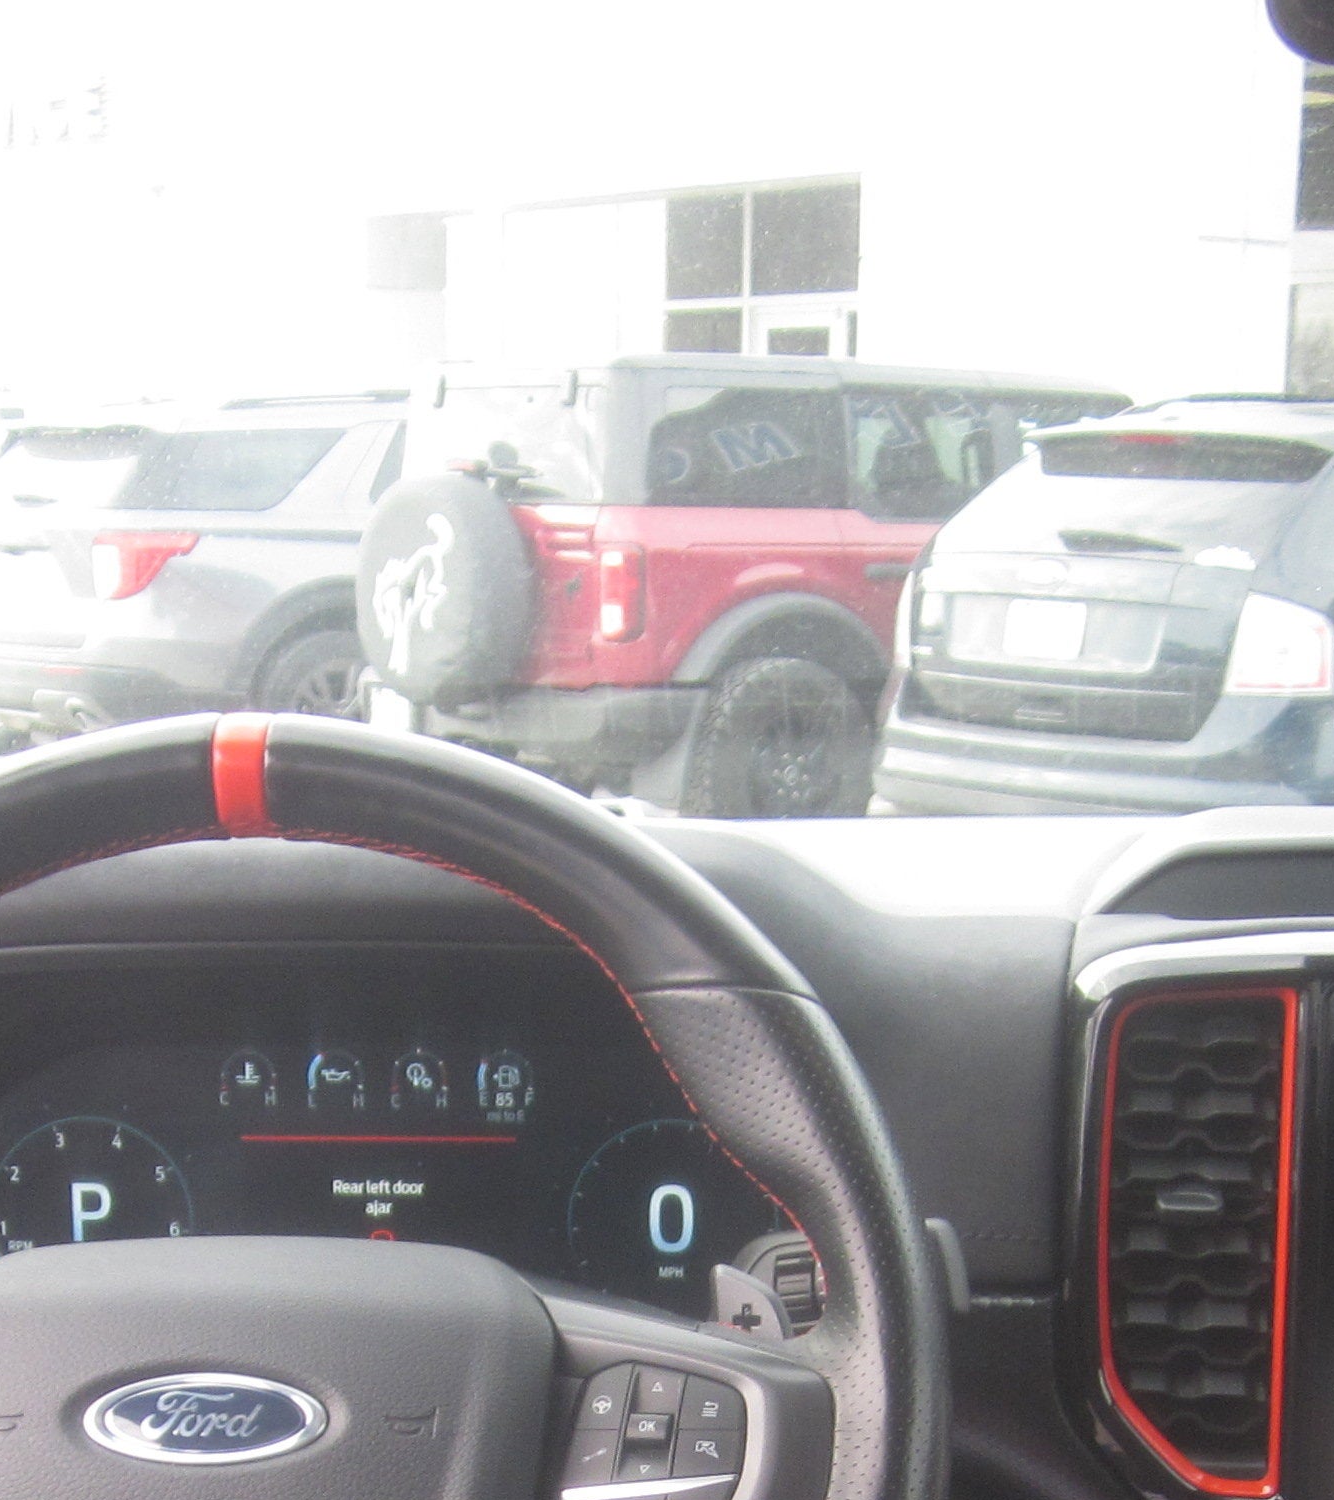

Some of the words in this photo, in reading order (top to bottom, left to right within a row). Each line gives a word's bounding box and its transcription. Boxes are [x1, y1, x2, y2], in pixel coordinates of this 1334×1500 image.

[495, 1092, 514, 1107] 85
[55, 1132, 65, 1148] 3
[111, 1134, 122, 1149] 4
[10, 1166, 21, 1182] 2
[155, 1166, 166, 1182] 5
[333, 1180, 365, 1195] Rear
[367, 1180, 390, 1195] left
[393, 1180, 424, 1195] door
[70, 1181, 112, 1242] P
[365, 1200, 393, 1216] ajar
[649, 1184, 694, 1253] 0
[0, 1221, 7, 1235] 1
[169, 1222, 180, 1237] 6
[658, 1266, 685, 1279] MPH
[140, 1389, 264, 1445] Ford
[638, 1420, 656, 1432] OK
